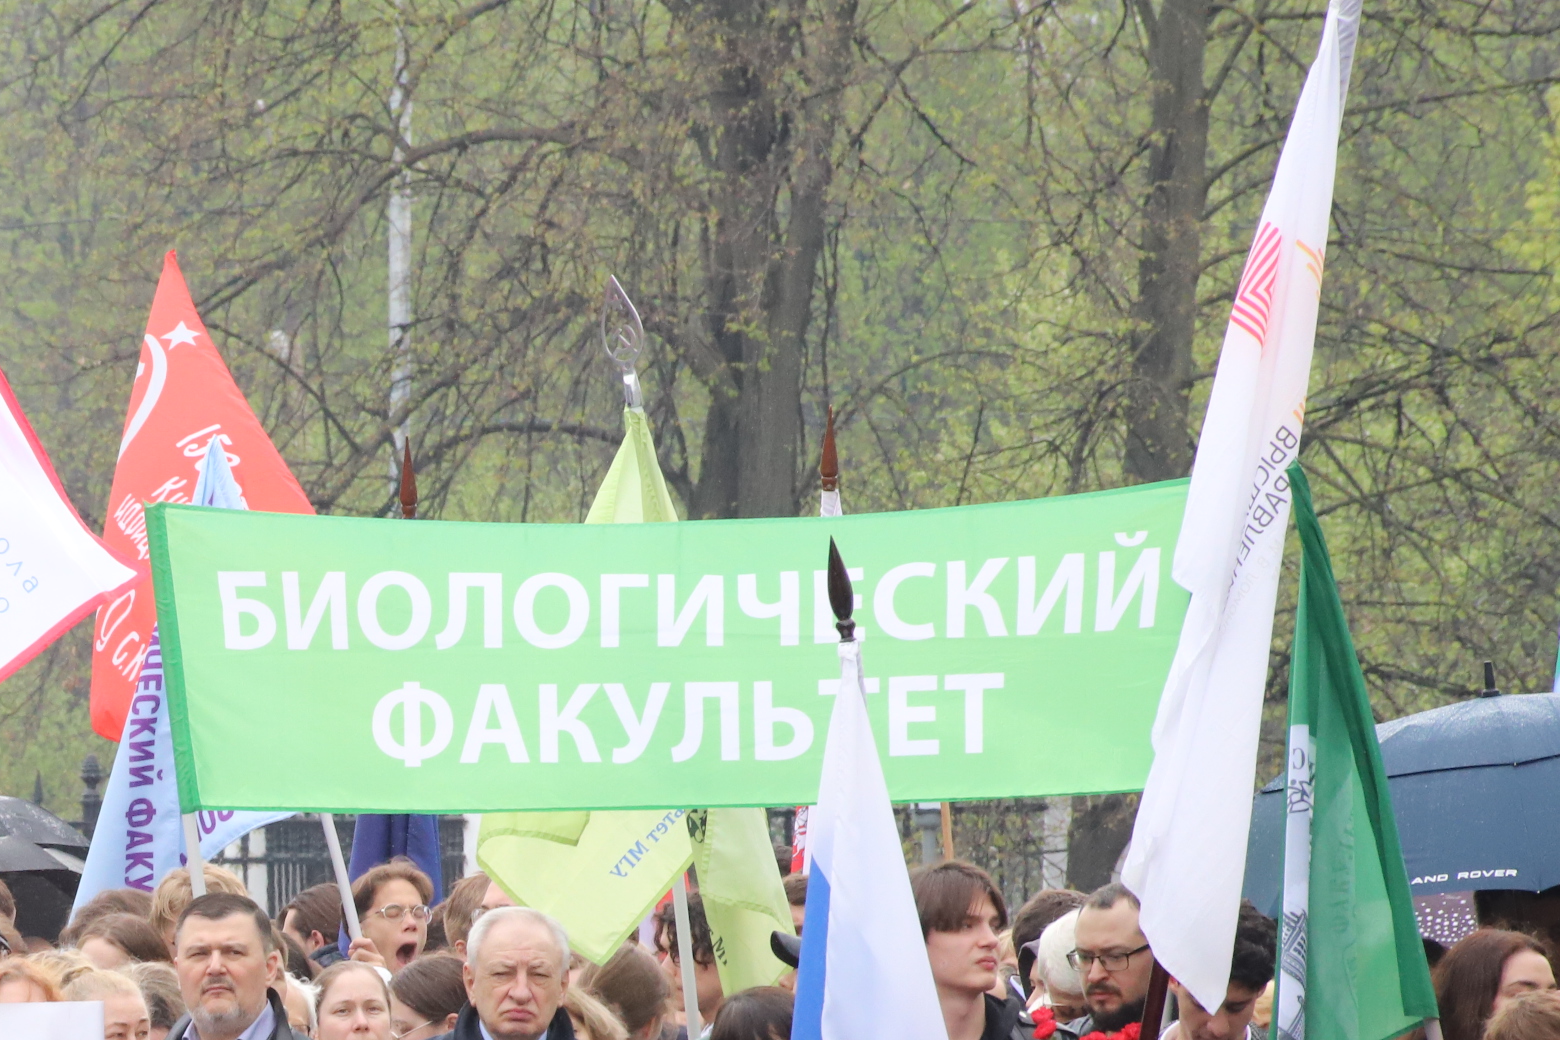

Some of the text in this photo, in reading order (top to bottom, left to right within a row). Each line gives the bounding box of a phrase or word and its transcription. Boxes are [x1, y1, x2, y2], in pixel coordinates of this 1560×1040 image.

[217, 530, 1162, 651] БИОЛОГИЧЕСКИЙ
[1410, 868, 1518, 885] AND ROVER
